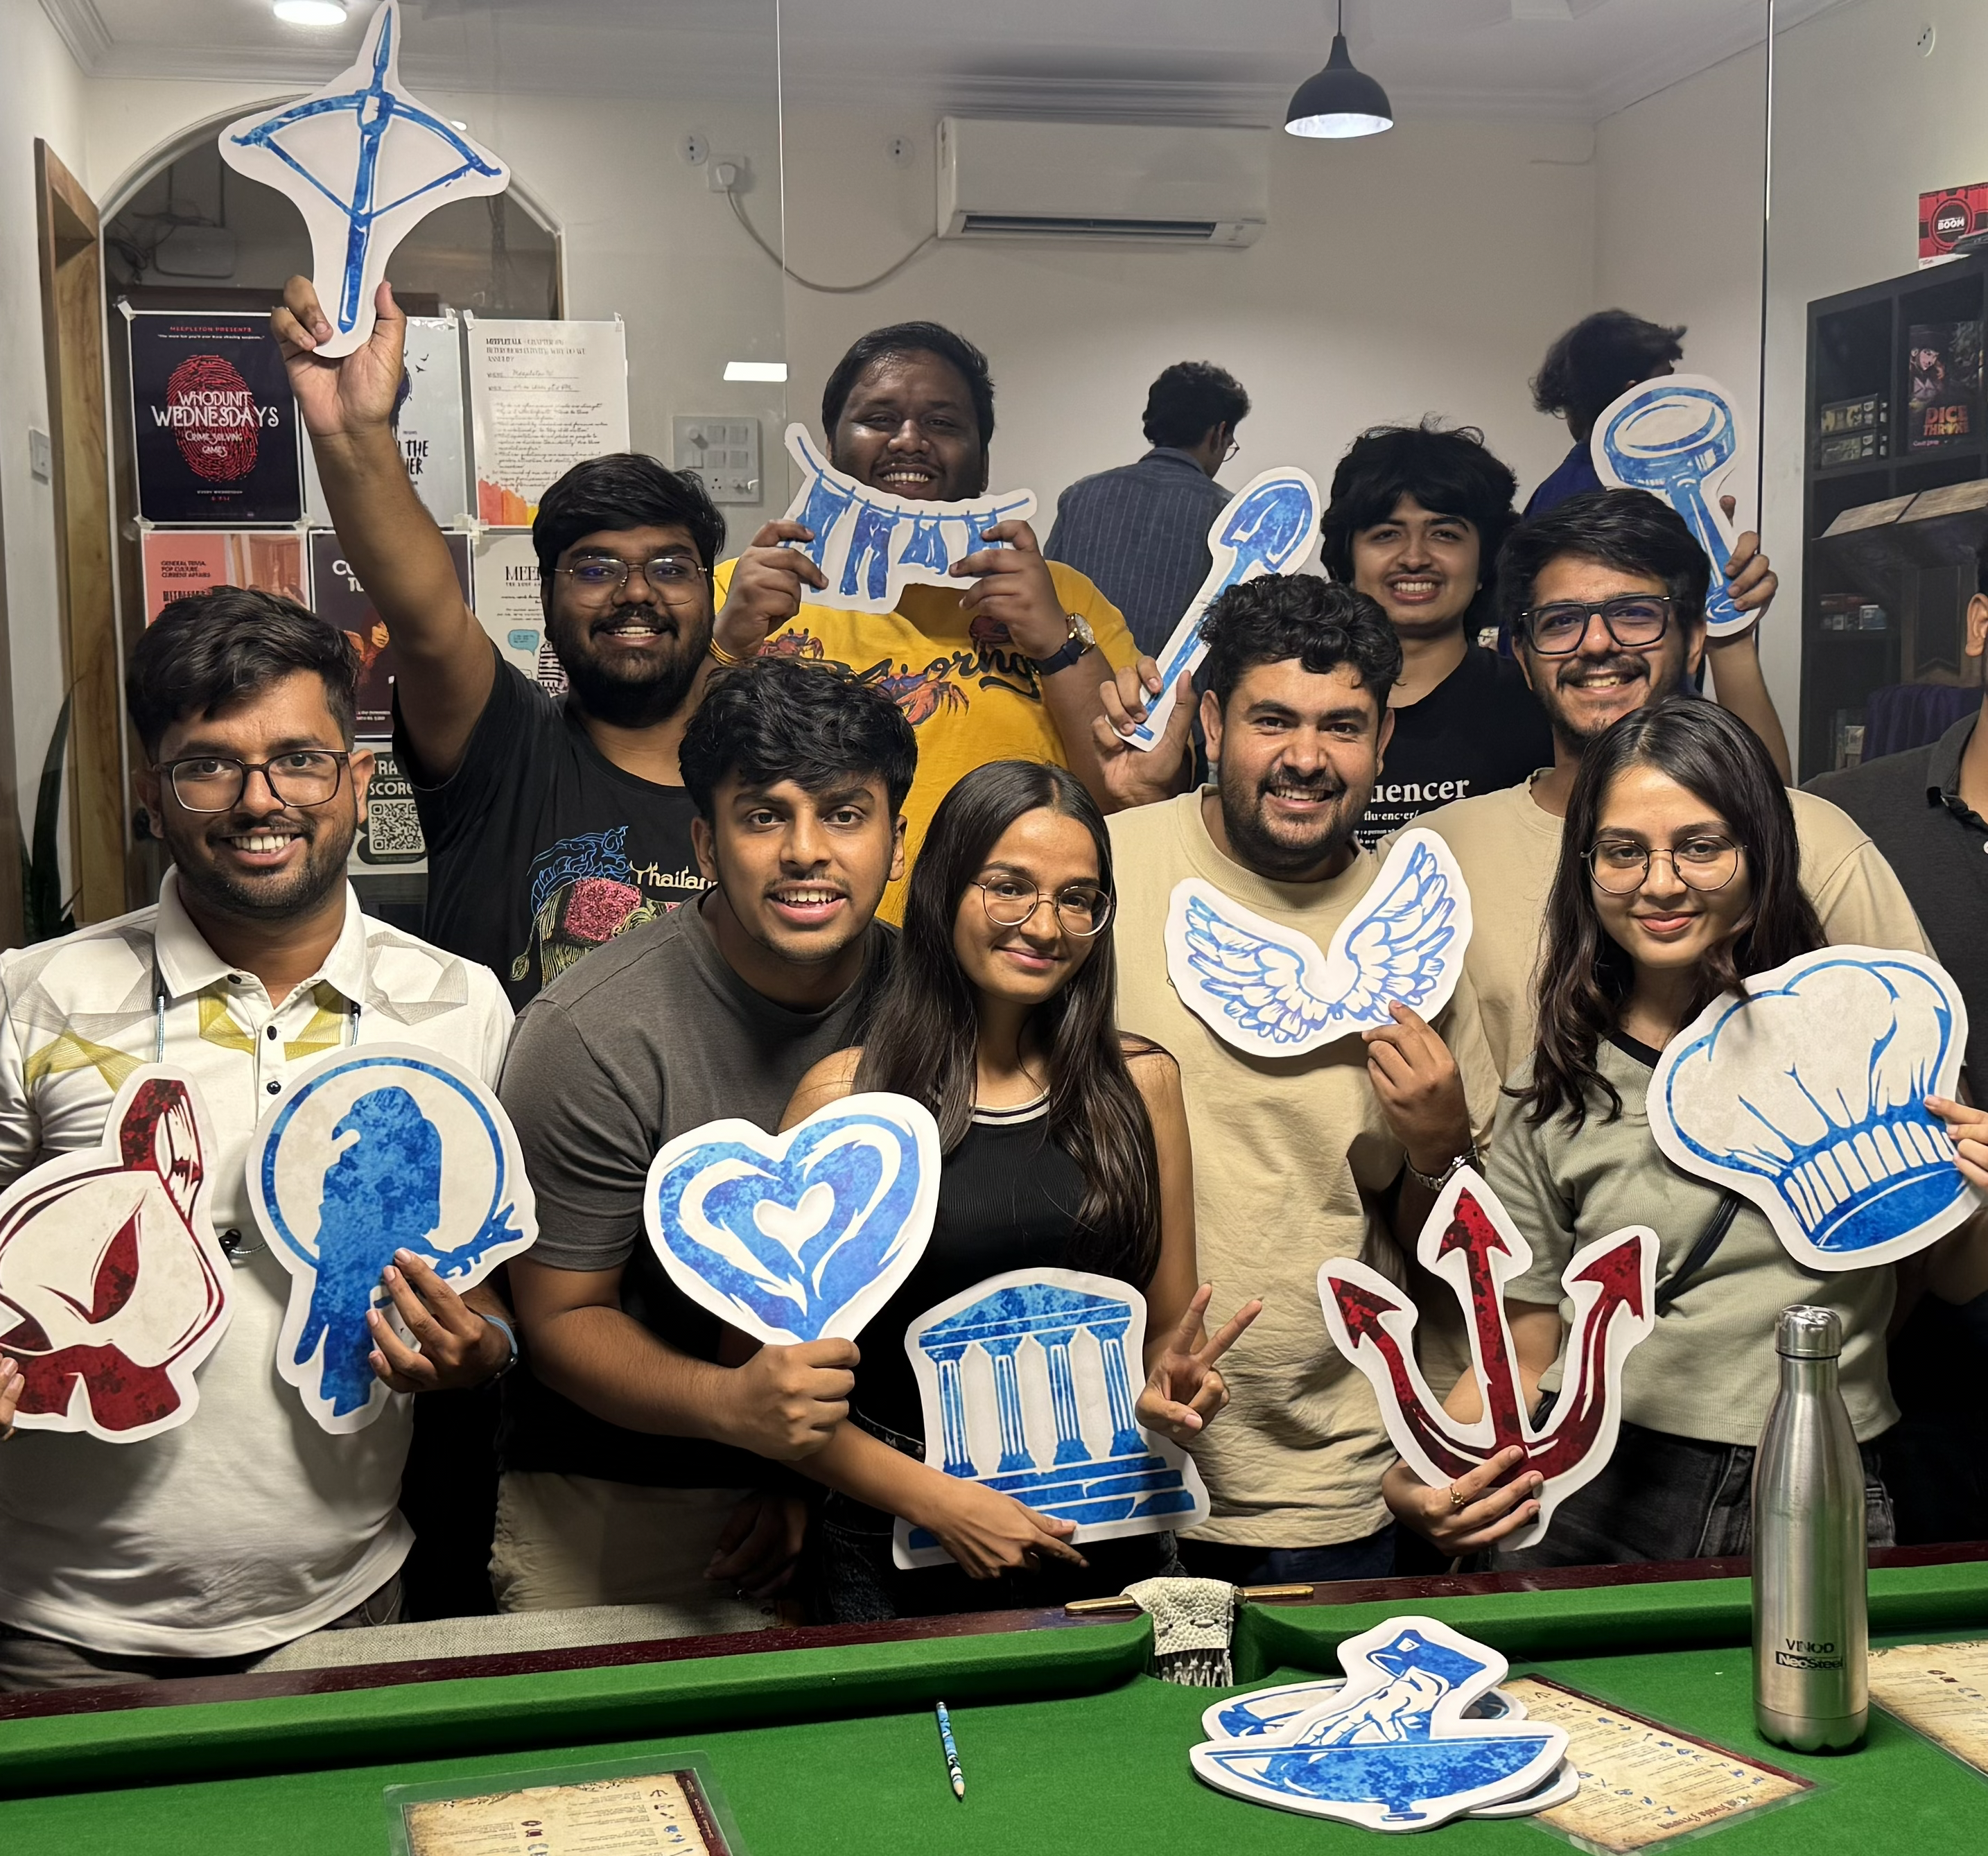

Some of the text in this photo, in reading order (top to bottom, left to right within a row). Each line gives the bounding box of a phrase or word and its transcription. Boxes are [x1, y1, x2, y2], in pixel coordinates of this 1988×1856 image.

[1937, 218, 1964, 230] BOOM
[178, 391, 252, 406] WHODUNIT
[151, 406, 279, 427] WEDNESDAYS
[406, 440, 429, 458] THE
[1371, 779, 1470, 803] uencer
[629, 860, 718, 890] Thailan
[1786, 1638, 1835, 1653] VINOD
[1778, 1653, 1842, 1669] NeoSteel
